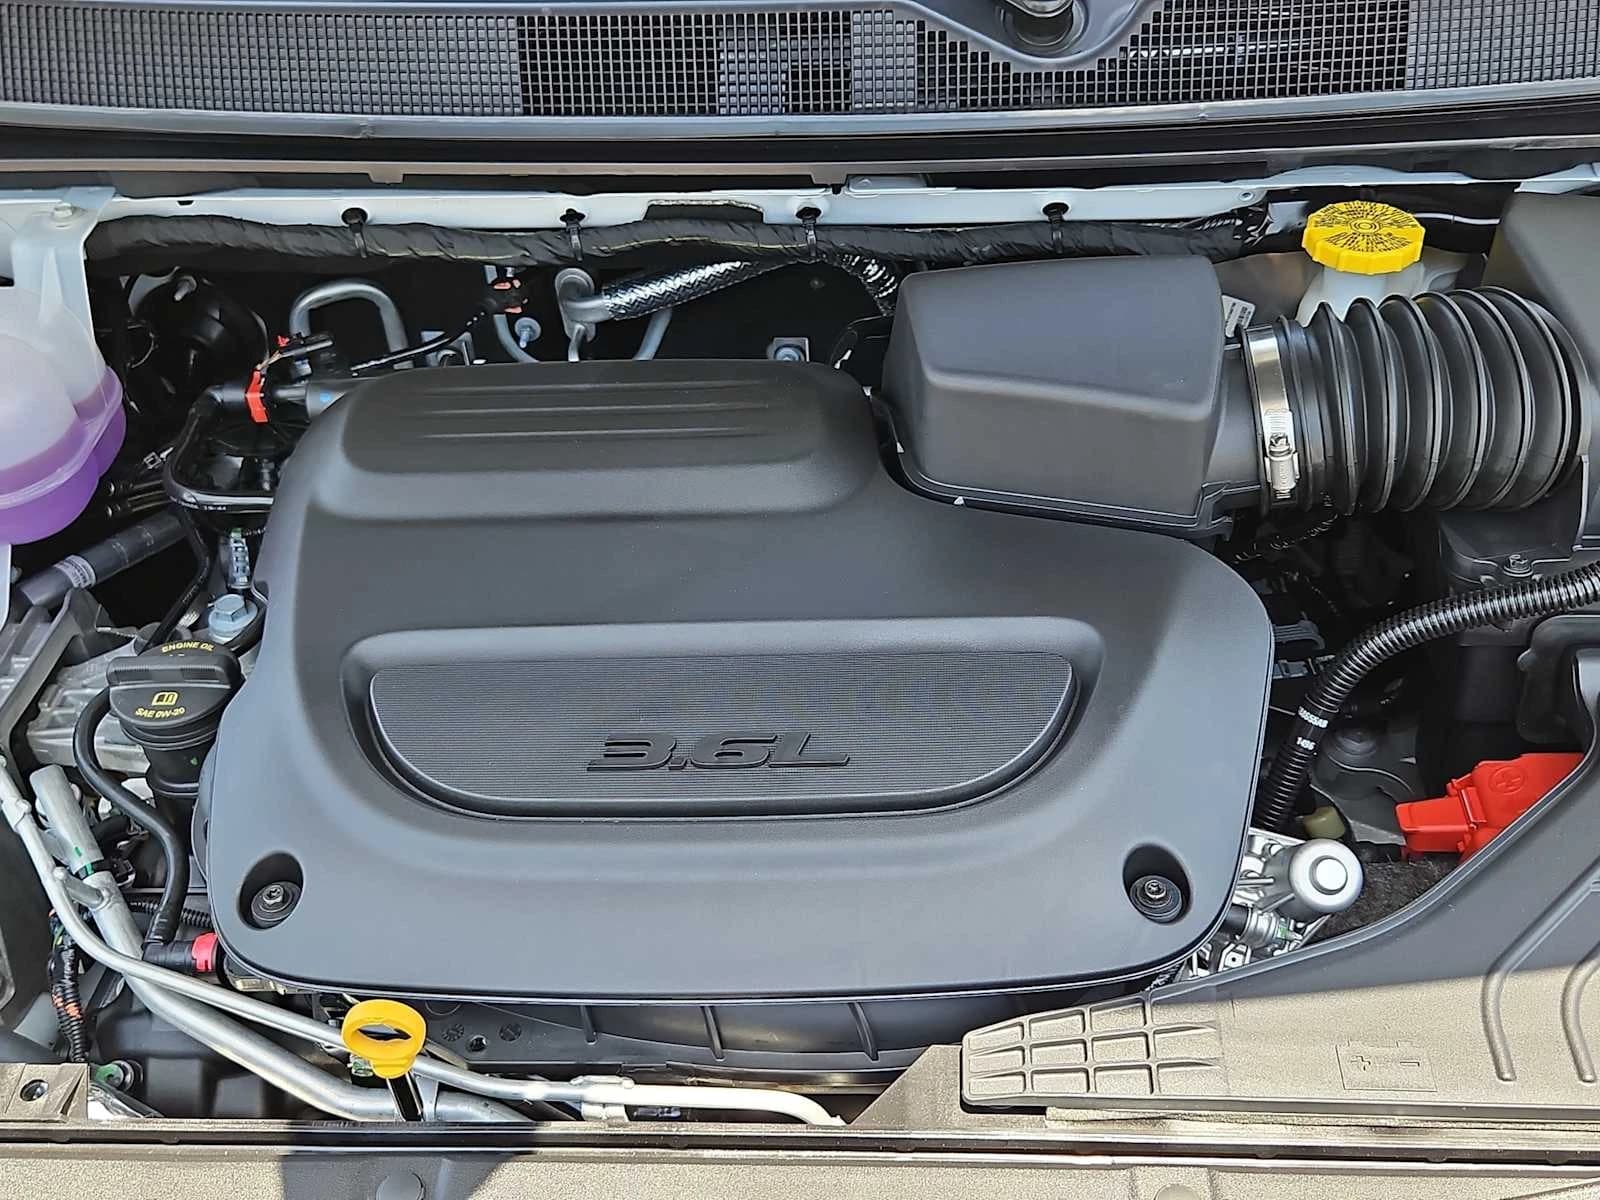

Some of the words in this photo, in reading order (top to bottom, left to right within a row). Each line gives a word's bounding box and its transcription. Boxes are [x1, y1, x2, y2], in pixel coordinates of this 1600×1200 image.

[161, 641, 200, 653] ENGINE
[200, 642, 215, 652] OIL
[135, 707, 154, 718] SAE
[155, 707, 186, 718] 0W-20
[586, 731, 850, 771] 3.6L
